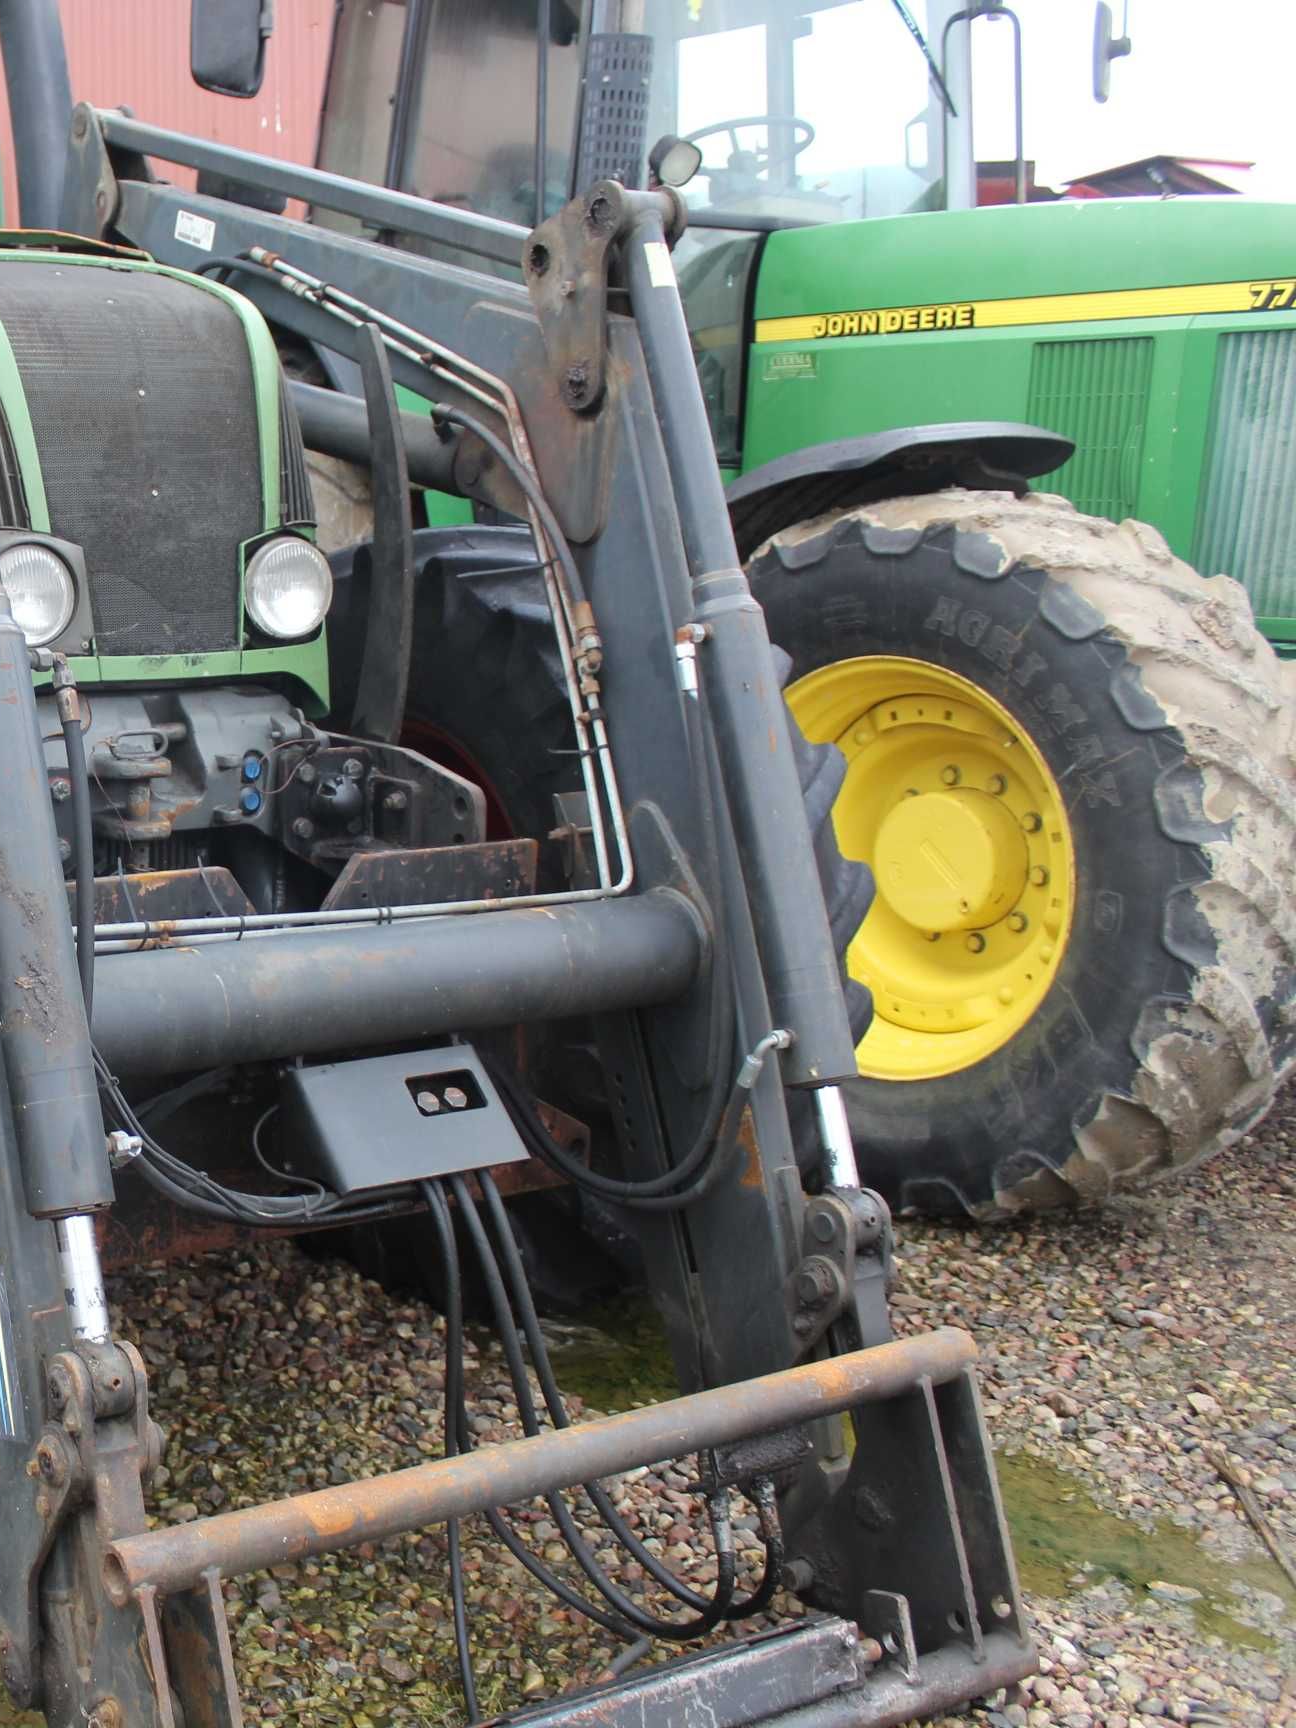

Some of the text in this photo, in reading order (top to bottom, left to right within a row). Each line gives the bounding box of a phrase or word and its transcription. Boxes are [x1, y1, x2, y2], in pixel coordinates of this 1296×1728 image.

[1249, 282, 1296, 310] 77
[814, 304, 974, 339] JOHN DEERE
